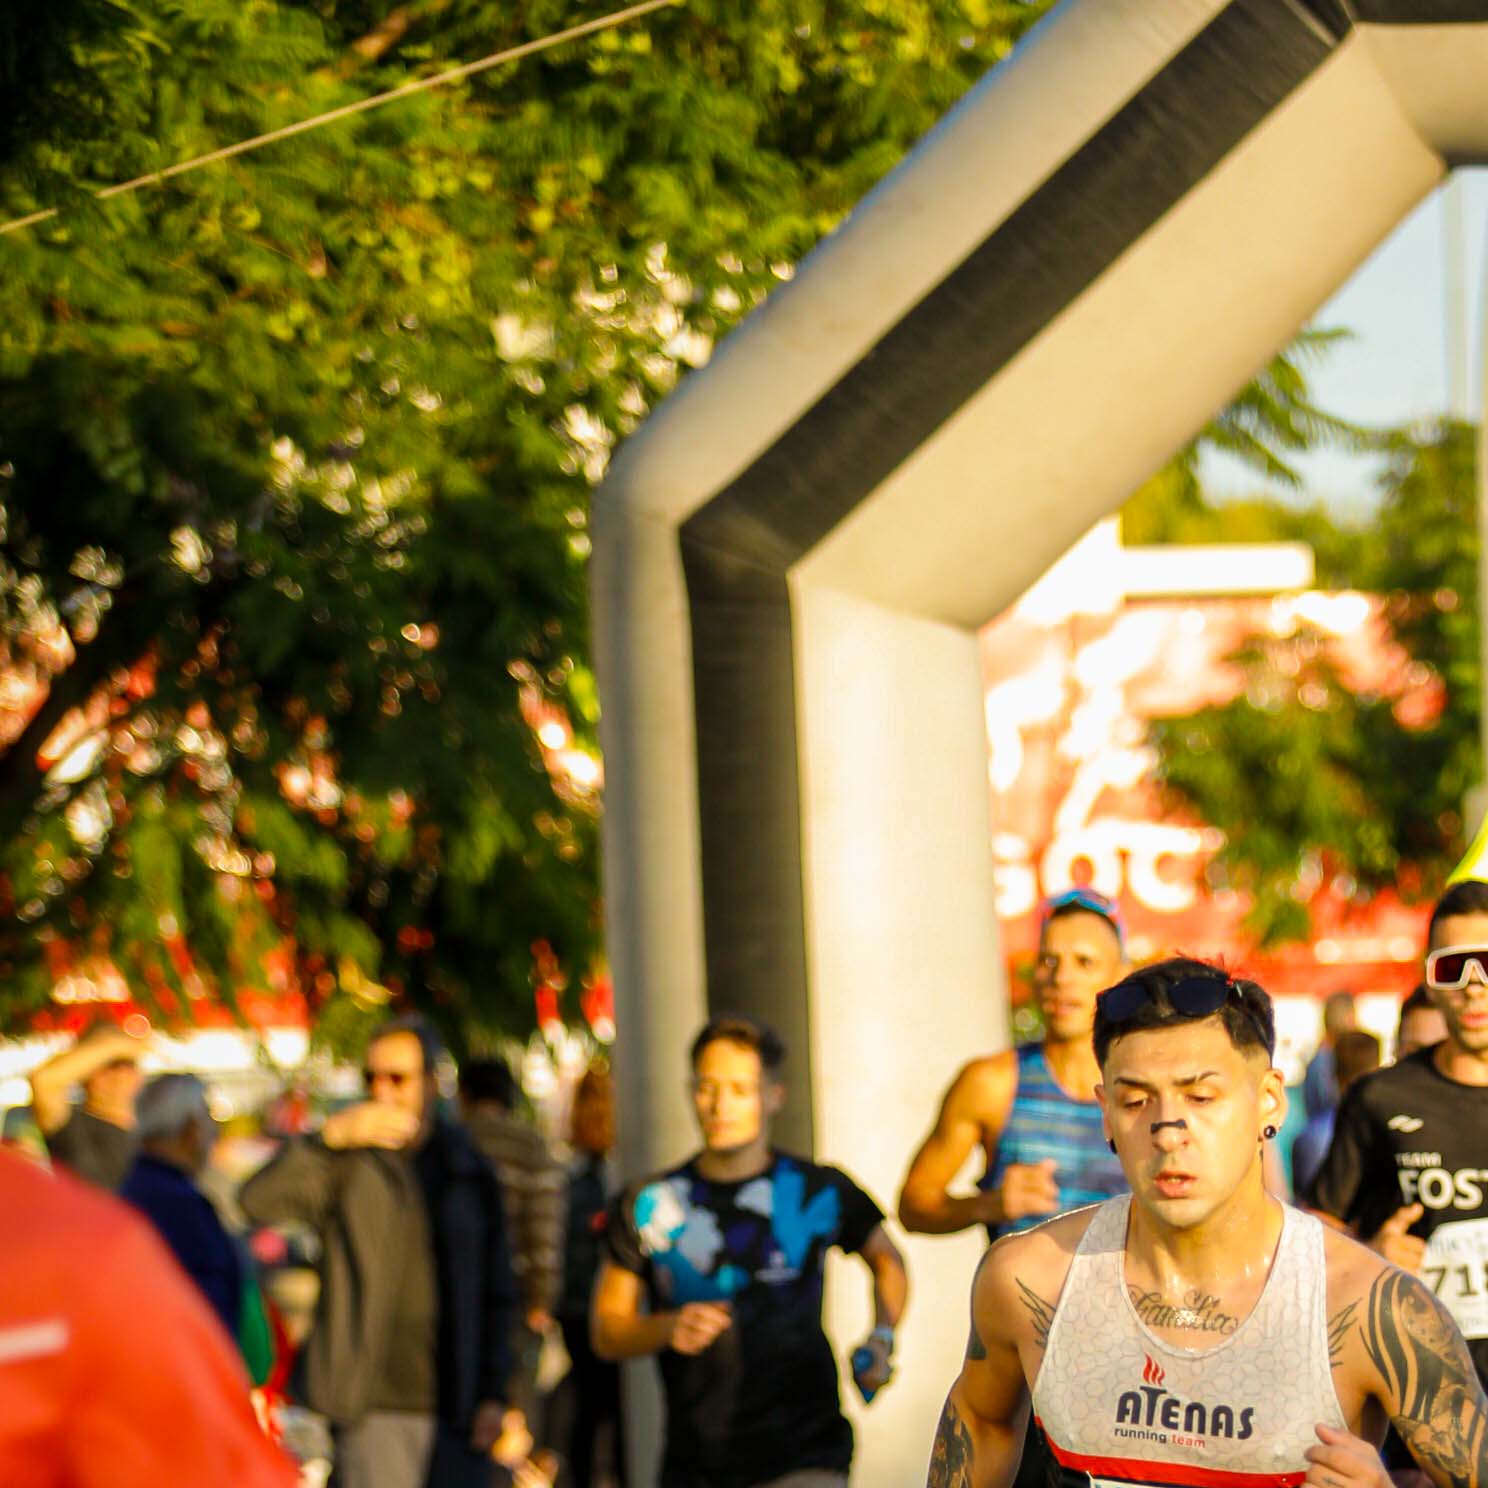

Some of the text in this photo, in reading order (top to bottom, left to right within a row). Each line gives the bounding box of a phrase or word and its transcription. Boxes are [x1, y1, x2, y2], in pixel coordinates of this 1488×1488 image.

[1116, 1385, 1255, 1440] ATENAS
[1114, 1427, 1206, 1448] running team
